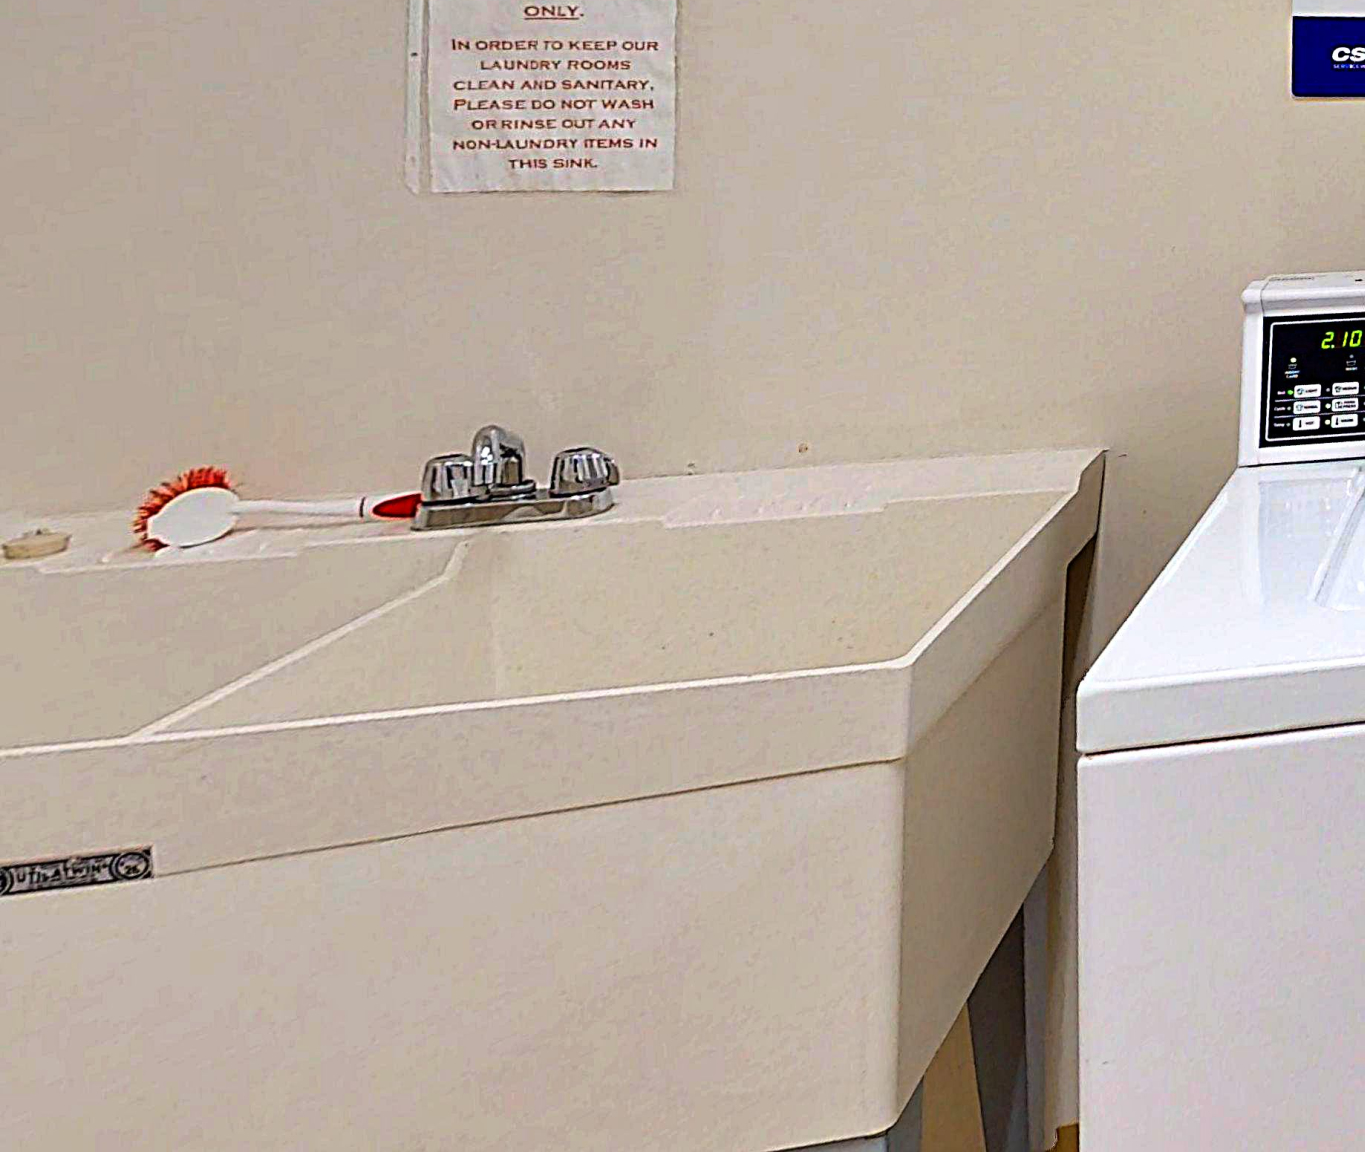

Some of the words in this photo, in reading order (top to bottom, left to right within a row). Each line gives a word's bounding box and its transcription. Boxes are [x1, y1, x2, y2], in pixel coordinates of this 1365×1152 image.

[452, 39, 469, 50] IN
[475, 40, 538, 51] ORDER
[544, 40, 563, 51] TO
[569, 41, 617, 51] KEEP
[622, 41, 658, 51] OUR
[480, 60, 561, 70] LAUNDRY
[568, 61, 630, 69] ROOMS
[453, 80, 514, 90] CLEAN
[521, 80, 556, 90] AND
[453, 100, 525, 110] PLEASE
[532, 100, 555, 109] DO
[561, 100, 597, 109] NOT
[602, 100, 654, 109] WASH
[472, 120, 497, 129] OR
[504, 120, 557, 129] RINSE
[562, 120, 595, 128] OUT
[599, 120, 636, 128] ANY
[453, 139, 577, 150] NON-LAUNDRY
[584, 139, 633, 148] ITEMS
[640, 138, 657, 148] IN
[509, 159, 547, 169] THIS
[1321, 330, 1362, 349] 2.10
